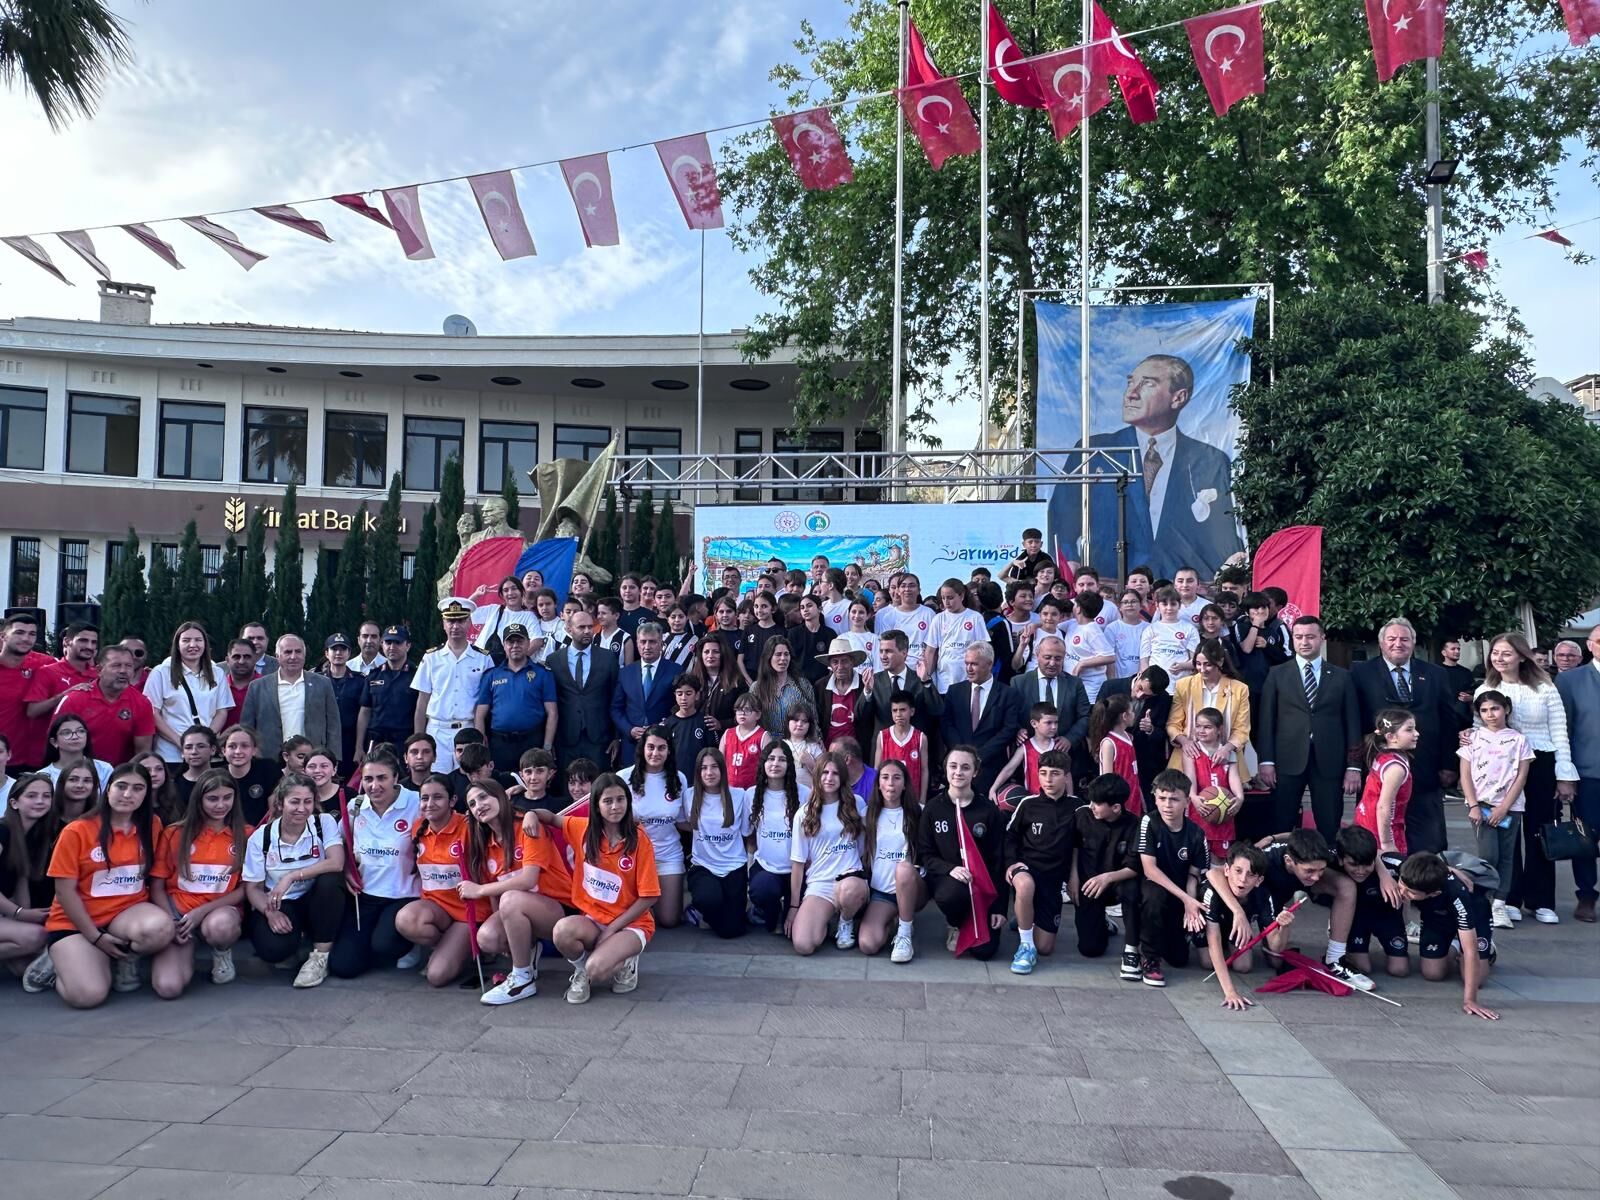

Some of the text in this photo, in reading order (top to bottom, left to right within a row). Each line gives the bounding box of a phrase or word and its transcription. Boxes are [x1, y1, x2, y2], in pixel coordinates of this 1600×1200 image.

[254, 505, 320, 530] irat
[731, 752, 744, 767] 15
[1210, 773, 1219, 787] 5
[934, 820, 949, 834] 36
